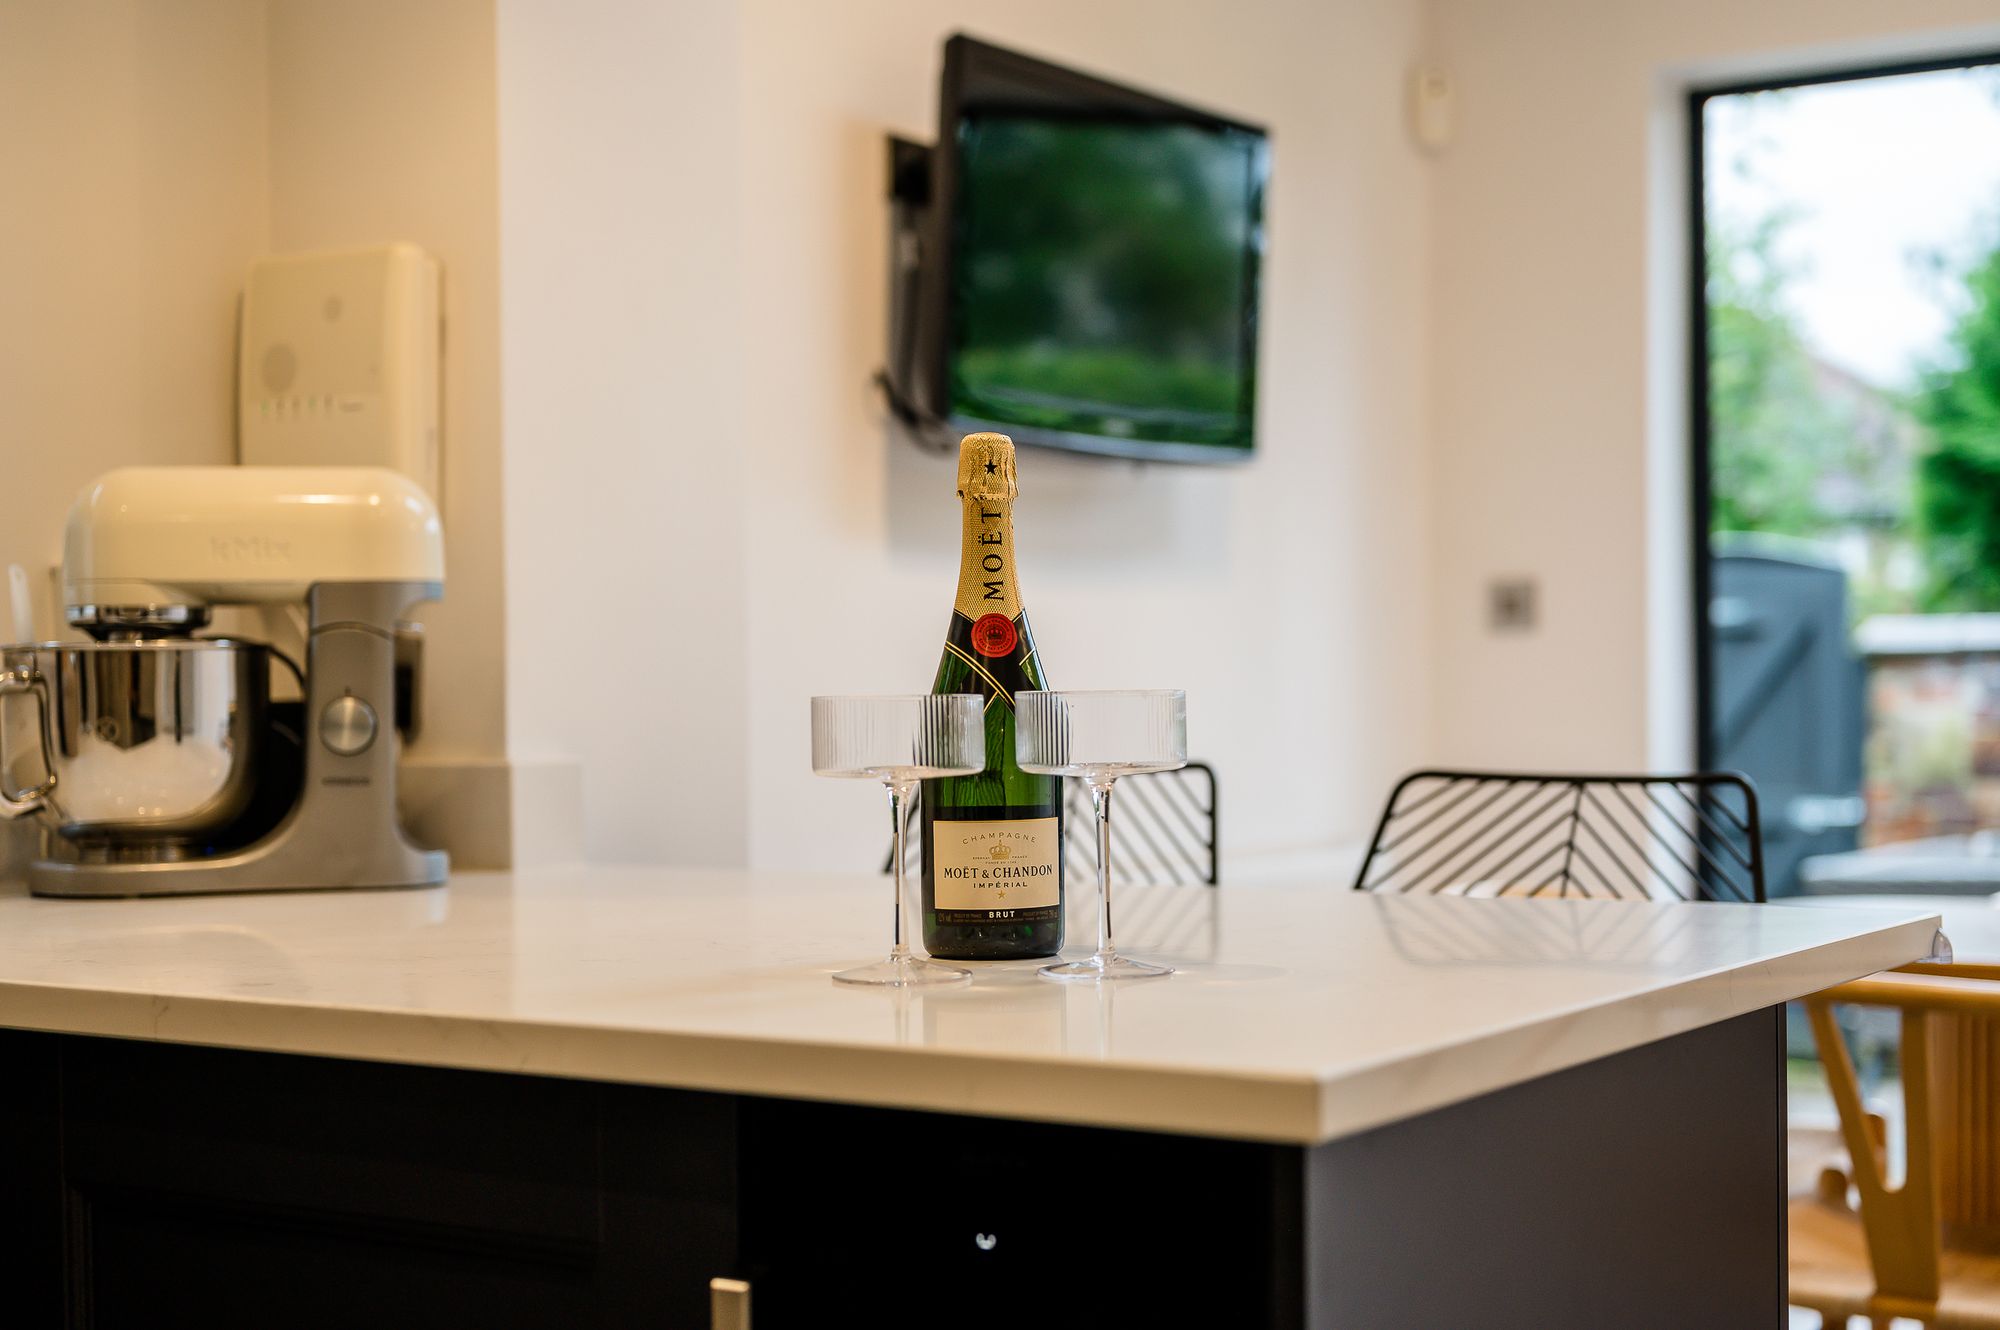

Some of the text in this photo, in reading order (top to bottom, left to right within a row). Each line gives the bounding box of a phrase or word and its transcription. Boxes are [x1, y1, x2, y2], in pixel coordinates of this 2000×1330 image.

[978, 507, 1004, 601] MOËT
[962, 832, 1037, 845] CHAMPAGNE
[944, 864, 1053, 879] MOËT & CHANDON
[973, 881, 1028, 889] IMPÉRIAL
[988, 911, 1015, 919] BRUT
